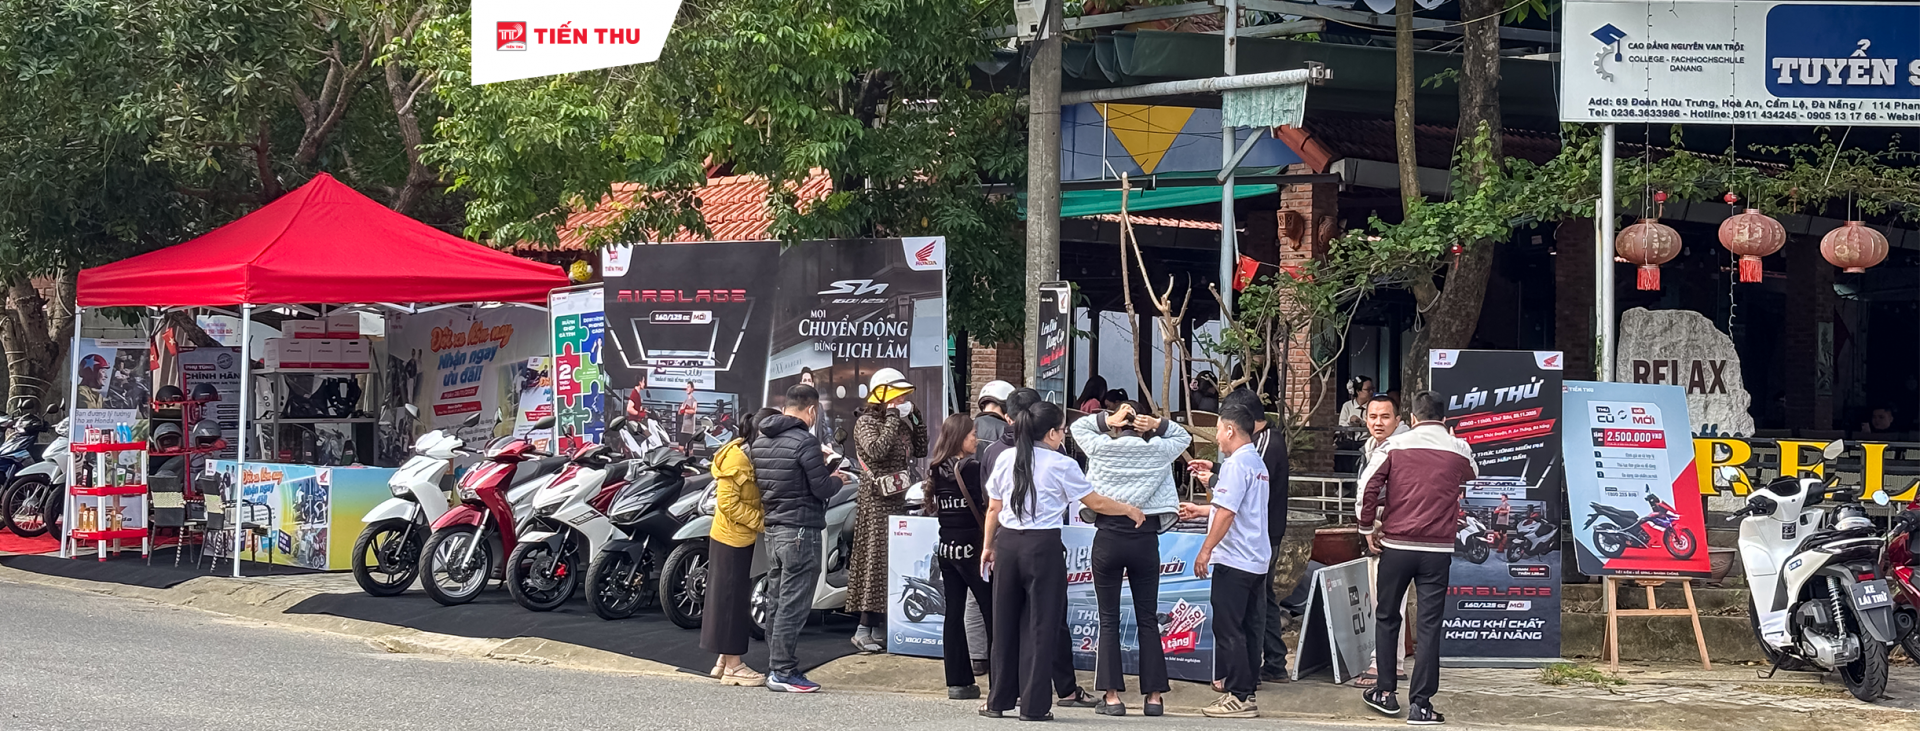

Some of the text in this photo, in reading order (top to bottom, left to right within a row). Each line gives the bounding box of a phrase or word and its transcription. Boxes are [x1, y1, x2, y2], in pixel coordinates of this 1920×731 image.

[1671, 56, 1744, 64] FACHHOCHSCHULE
[1772, 38, 1898, 86] TUYỂN
[1588, 98, 1613, 106] Add:
[1616, 98, 1628, 106] 69
[1631, 97, 1658, 106] Đoàn
[1661, 98, 1682, 106] Hữu
[1745, 100, 1762, 109] An,
[1812, 100, 1825, 108] Đà
[1828, 100, 1856, 110] Nẵng
[1872, 101, 1890, 110] 114
[1894, 102, 1920, 110] Phan
[1588, 108, 1608, 117] Tel:
[1610, 108, 1680, 118] 0236.3633986
[1733, 110, 1757, 119] 0911
[1760, 110, 1797, 119] 434245
[1806, 111, 1831, 120] 0905
[1835, 112, 1846, 120] 13
[1850, 112, 1862, 120] 17
[1864, 112, 1877, 120] 66
[617, 290, 746, 302] AIRBLADE
[810, 310, 826, 320] MỌI
[798, 314, 908, 340] CHUYỂN ĐỘNG
[814, 340, 908, 361] BỪNG LỊCH LÃM
[438, 345, 498, 370] Nhận ngay
[185, 371, 240, 380] CHÍNH HÃN
[559, 364, 571, 380] 2
[1448, 376, 1544, 410] LÁI THỬ
[1597, 414, 1655, 425] CŨ MỚI
[1607, 431, 1651, 443] 2.500.000
[1864, 585, 1875, 594] XE
[1858, 591, 1888, 605] LÁI THỬ
[1073, 621, 1096, 636] ĐỔI
[1442, 617, 1545, 628] NÂNG KHÍ CHẤT
[1480, 629, 1502, 640] TÀI
[1167, 636, 1189, 650] tặng
